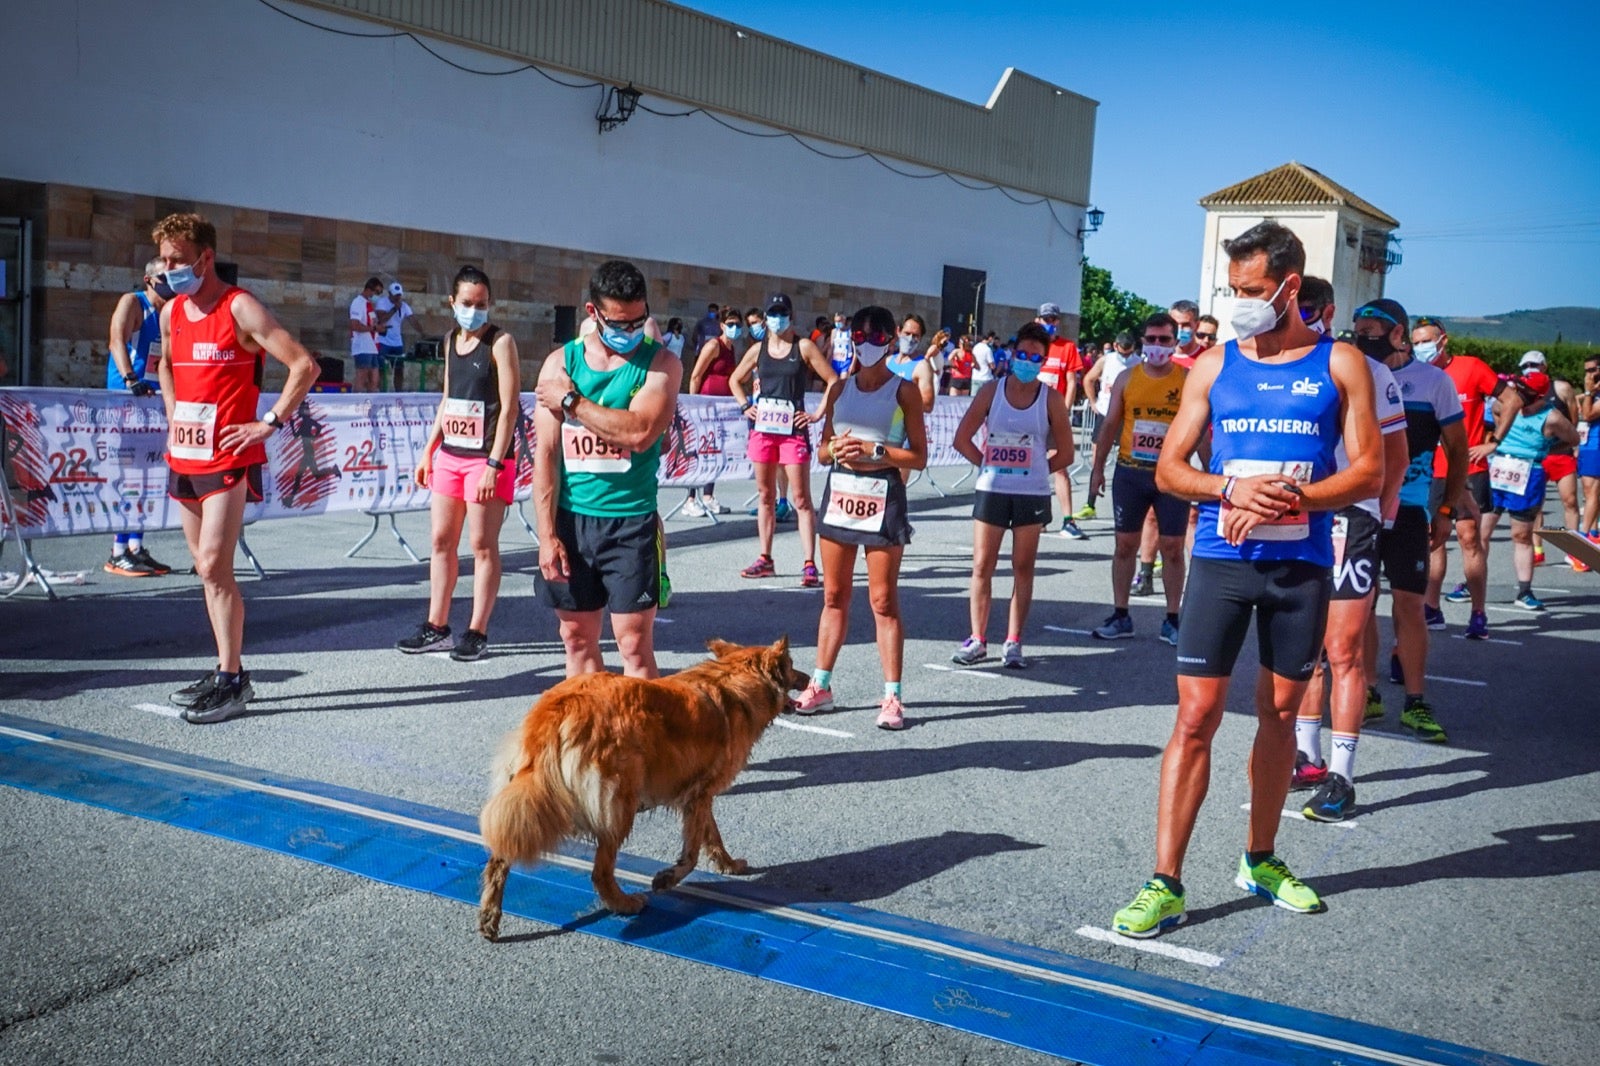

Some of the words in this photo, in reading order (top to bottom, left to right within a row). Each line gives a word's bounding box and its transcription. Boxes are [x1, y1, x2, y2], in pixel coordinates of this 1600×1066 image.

[762, 411, 789, 424] 2178
[445, 420, 476, 436] 1021
[1221, 418, 1320, 436] TROTASIERRA
[174, 426, 206, 446] 1018
[1138, 435, 1164, 450] 202
[991, 447, 1027, 463] 2059
[1493, 468, 1521, 482] 239
[837, 496, 878, 517] 1088
